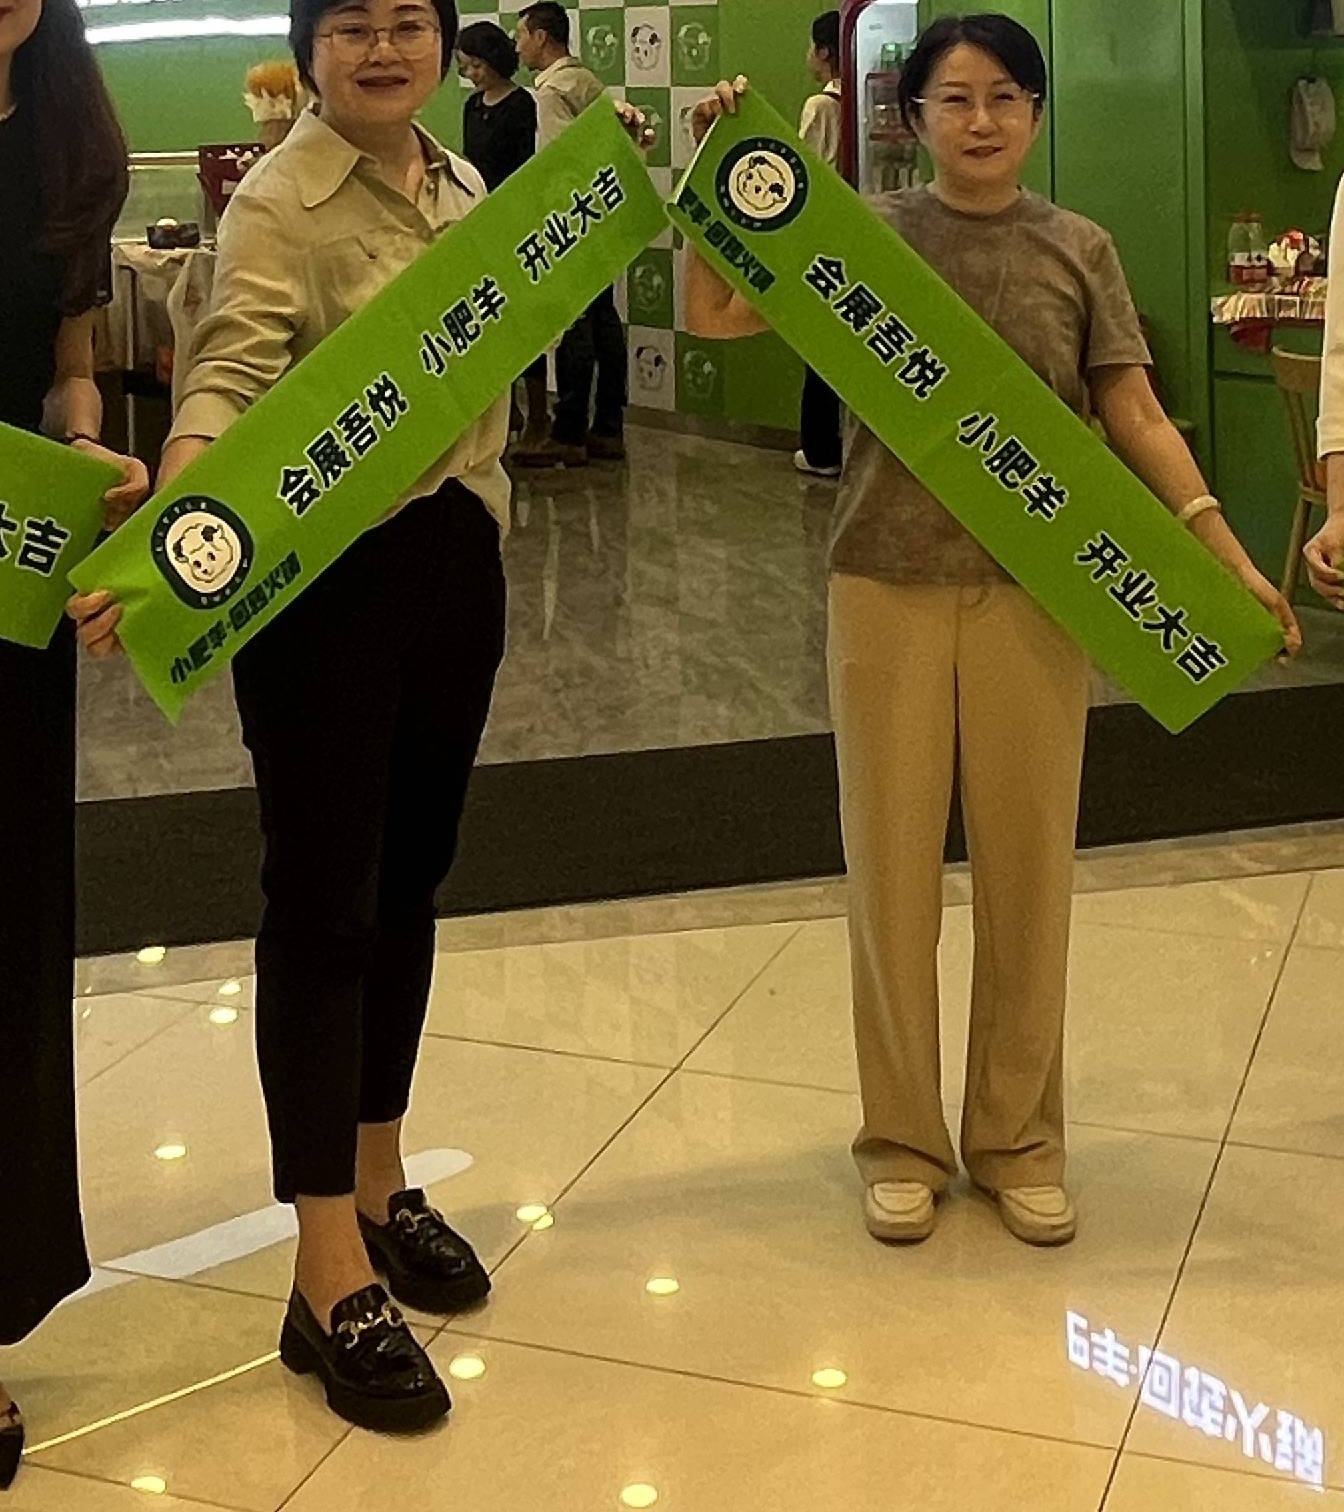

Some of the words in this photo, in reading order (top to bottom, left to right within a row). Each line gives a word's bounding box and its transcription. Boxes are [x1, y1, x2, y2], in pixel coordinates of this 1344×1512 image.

[277, 372, 410, 518] 会展吾悦
[418, 275, 508, 378] 小肥羊
[513, 164, 626, 283] 开业大吉
[802, 252, 952, 402] 会展吾悦
[955, 409, 1071, 524] 小肥羊
[1074, 531, 1231, 686] 开业大吉
